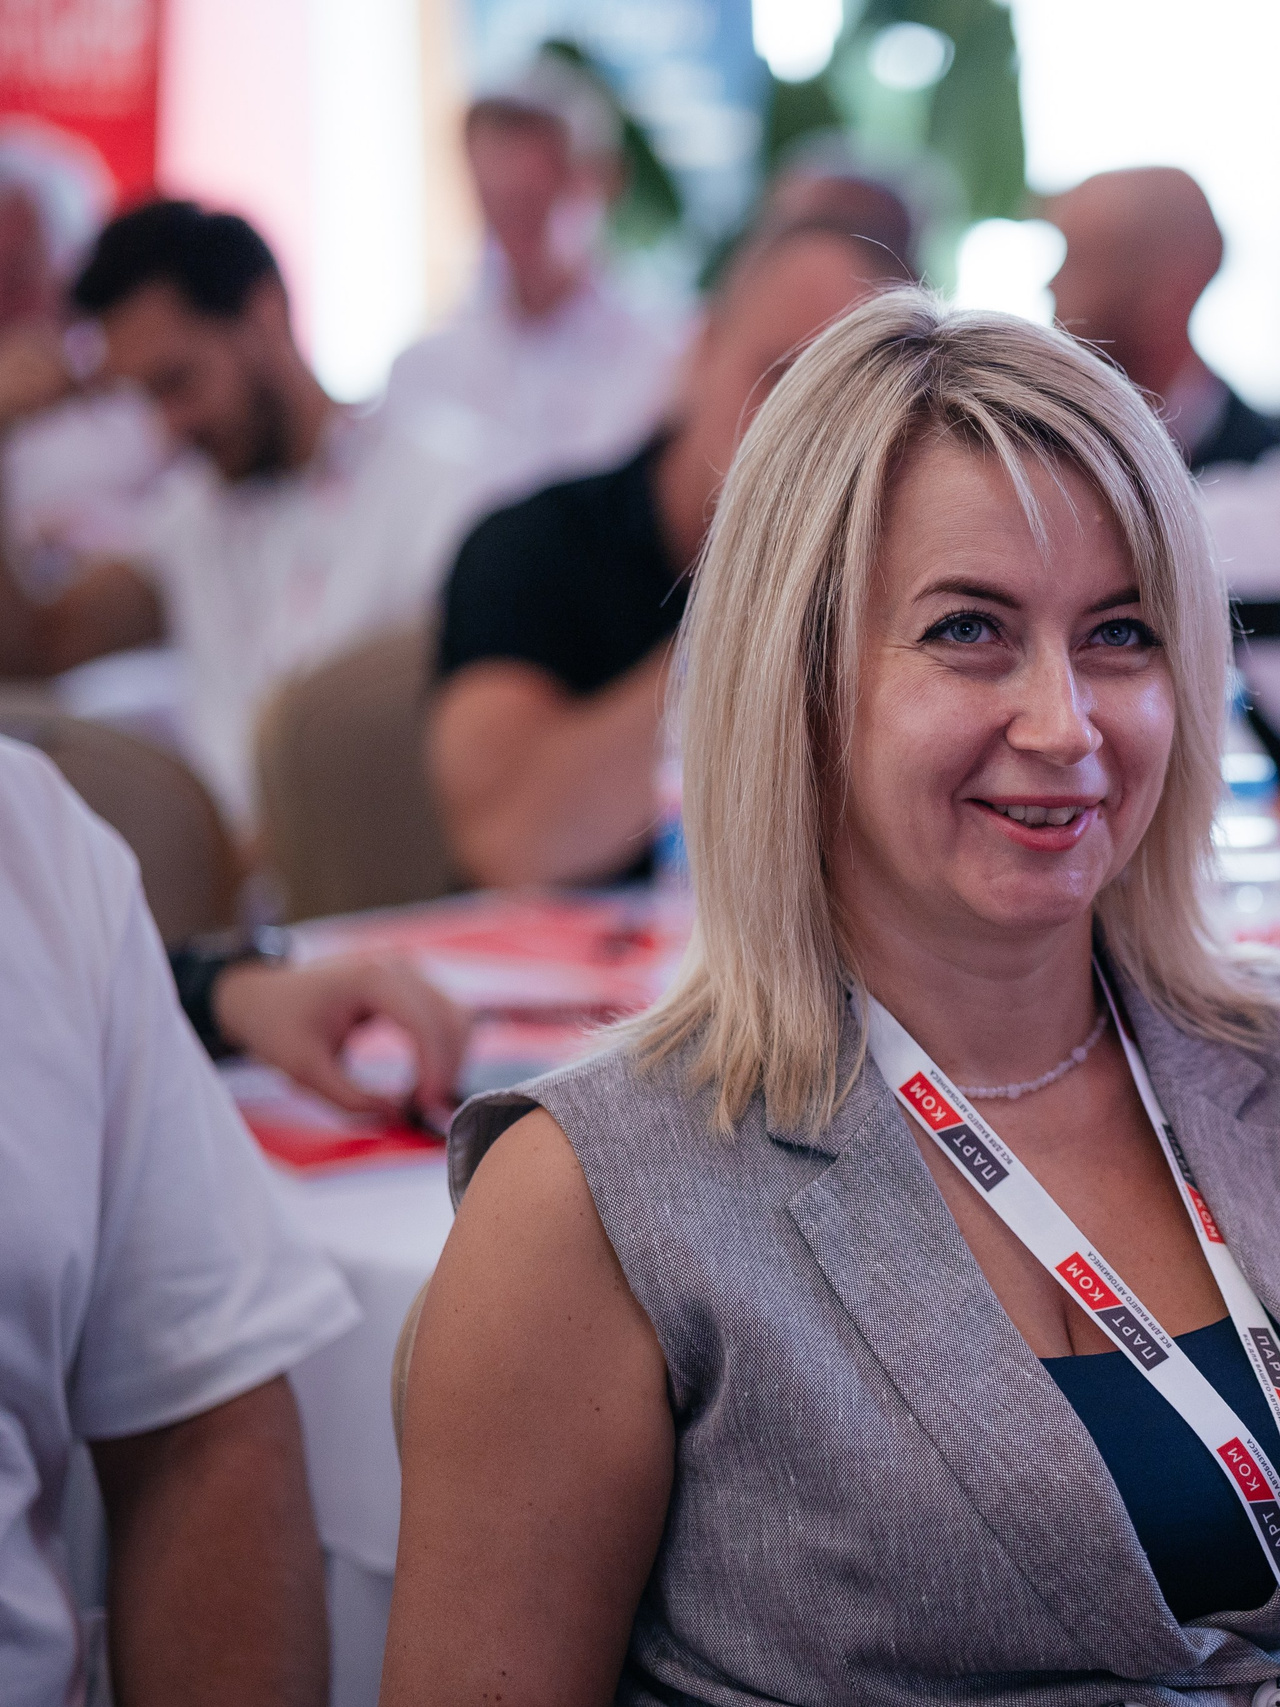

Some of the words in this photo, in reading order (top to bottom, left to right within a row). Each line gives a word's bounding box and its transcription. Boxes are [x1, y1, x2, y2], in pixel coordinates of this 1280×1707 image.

[909, 1081, 947, 1122] КОМ
[967, 1113, 991, 1140] ВАШЕГО
[953, 1134, 997, 1181] ПАРТ
[1000, 1152, 1014, 1165] ВСЕ
[1066, 1262, 1105, 1301] КОМ
[1087, 1251, 1127, 1296] АВТОБИЗНЕСА
[1125, 1296, 1150, 1323] ВАШЕГО
[1147, 1321, 1163, 1335] ДЛЯ
[1111, 1316, 1157, 1360] ПАРТ
[1159, 1335, 1172, 1349] ВСЕ
[1242, 1333, 1252, 1348] ВСЕ
[1255, 1363, 1271, 1391] ВАШЕГО
[1227, 1447, 1260, 1492] КОМ
[1246, 1438, 1280, 1490] АВТОБИЗНЕСА
